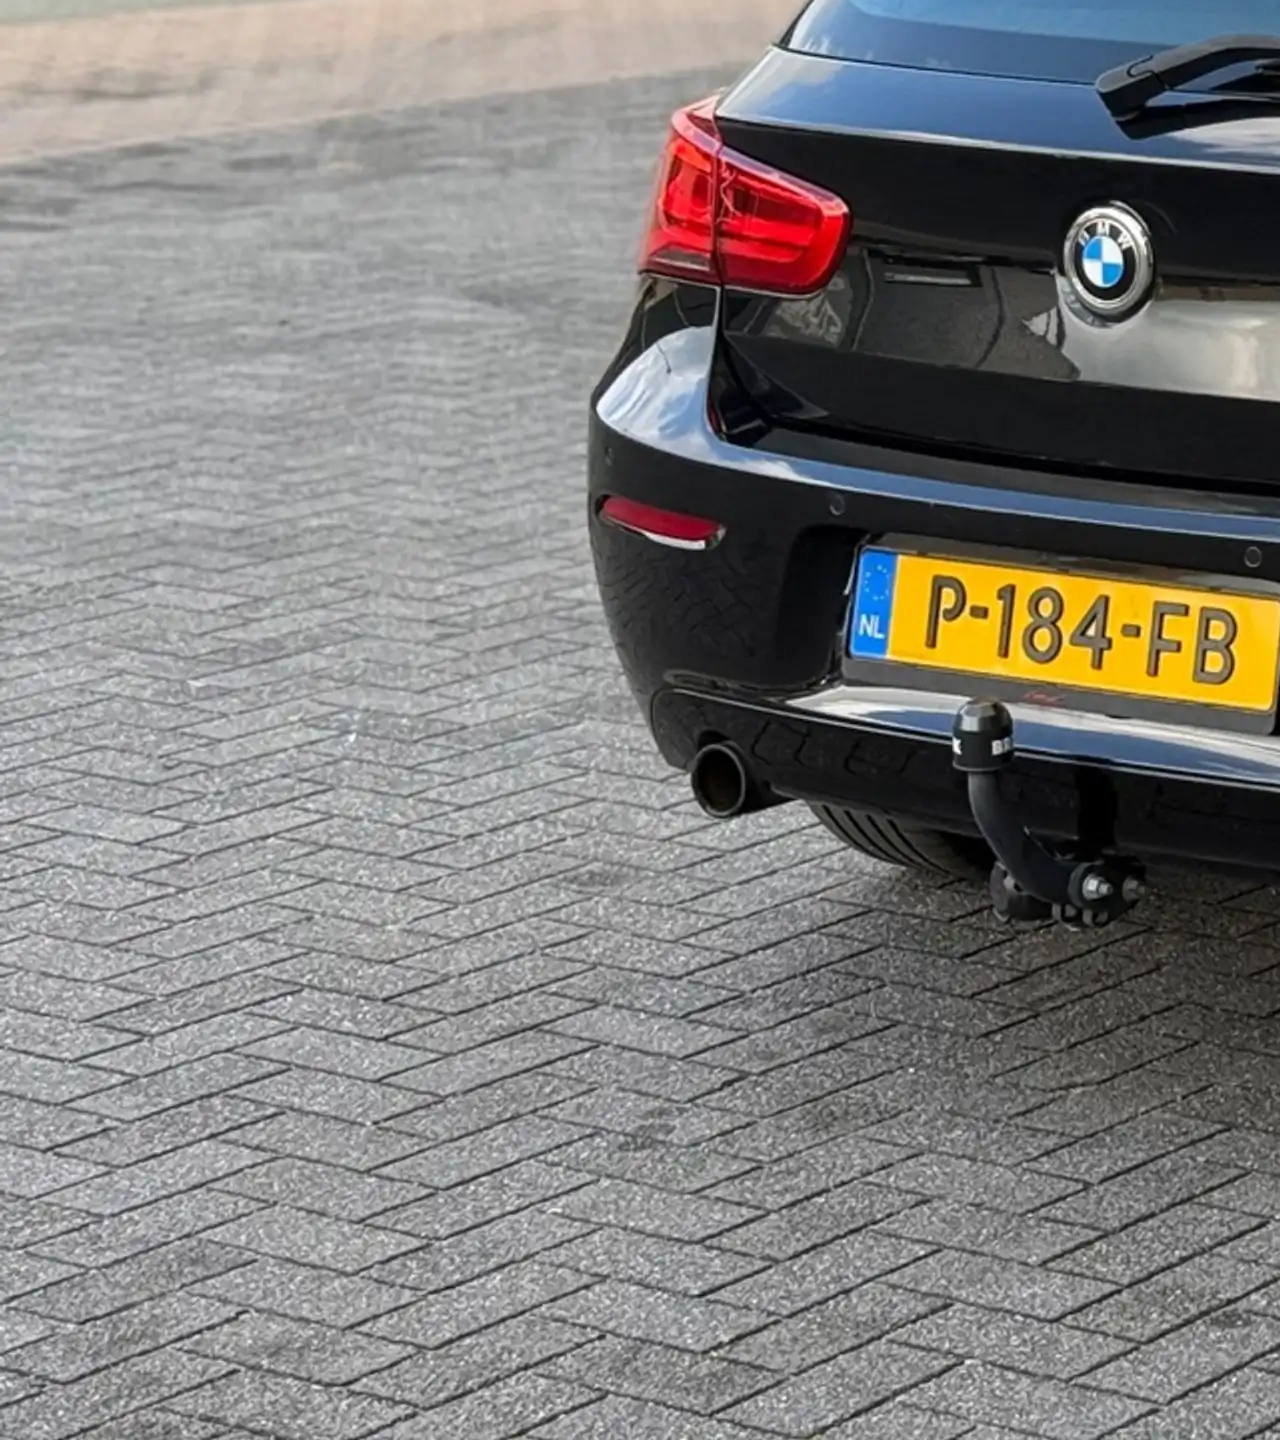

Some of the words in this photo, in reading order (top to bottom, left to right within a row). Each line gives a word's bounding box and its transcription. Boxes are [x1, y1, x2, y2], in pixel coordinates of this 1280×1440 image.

[1077, 220, 1132, 251] BMW
[860, 613, 885, 640] NL
[925, 574, 1239, 686] P-184-FB
